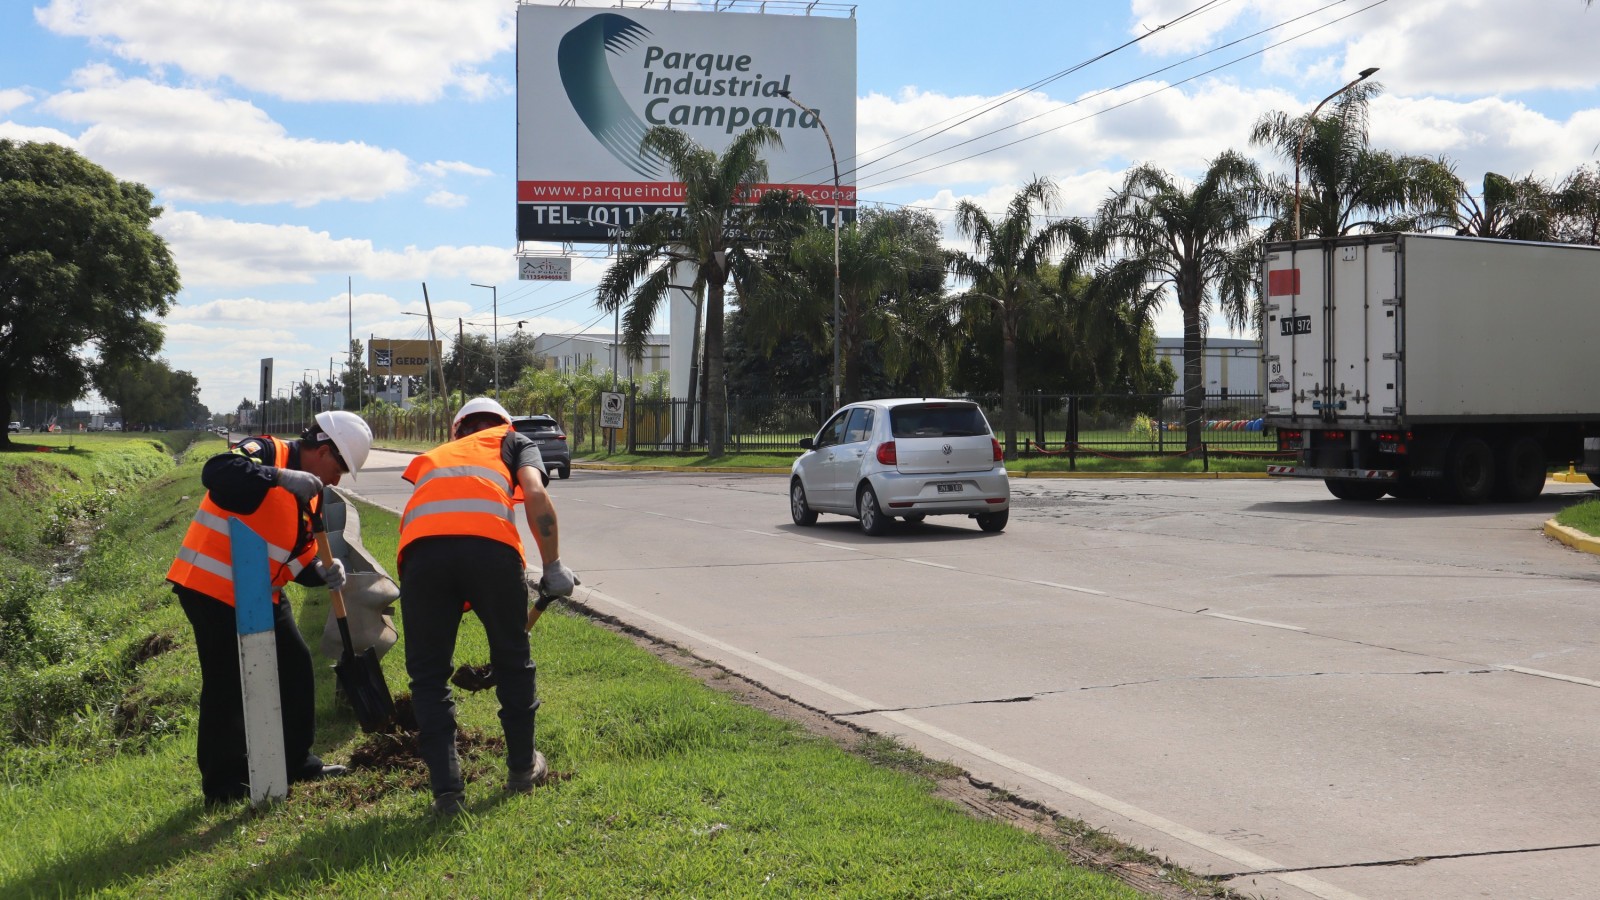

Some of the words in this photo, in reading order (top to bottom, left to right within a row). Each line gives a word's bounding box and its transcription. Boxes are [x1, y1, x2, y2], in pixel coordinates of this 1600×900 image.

[643, 46, 752, 76] Parque
[643, 71, 791, 97] Industrial
[645, 97, 821, 134] Campana
[533, 205, 581, 224] TEL.
[1297, 319, 1311, 332] 972
[396, 357, 430, 366] GERDA
[1271, 363, 1281, 374] 80
